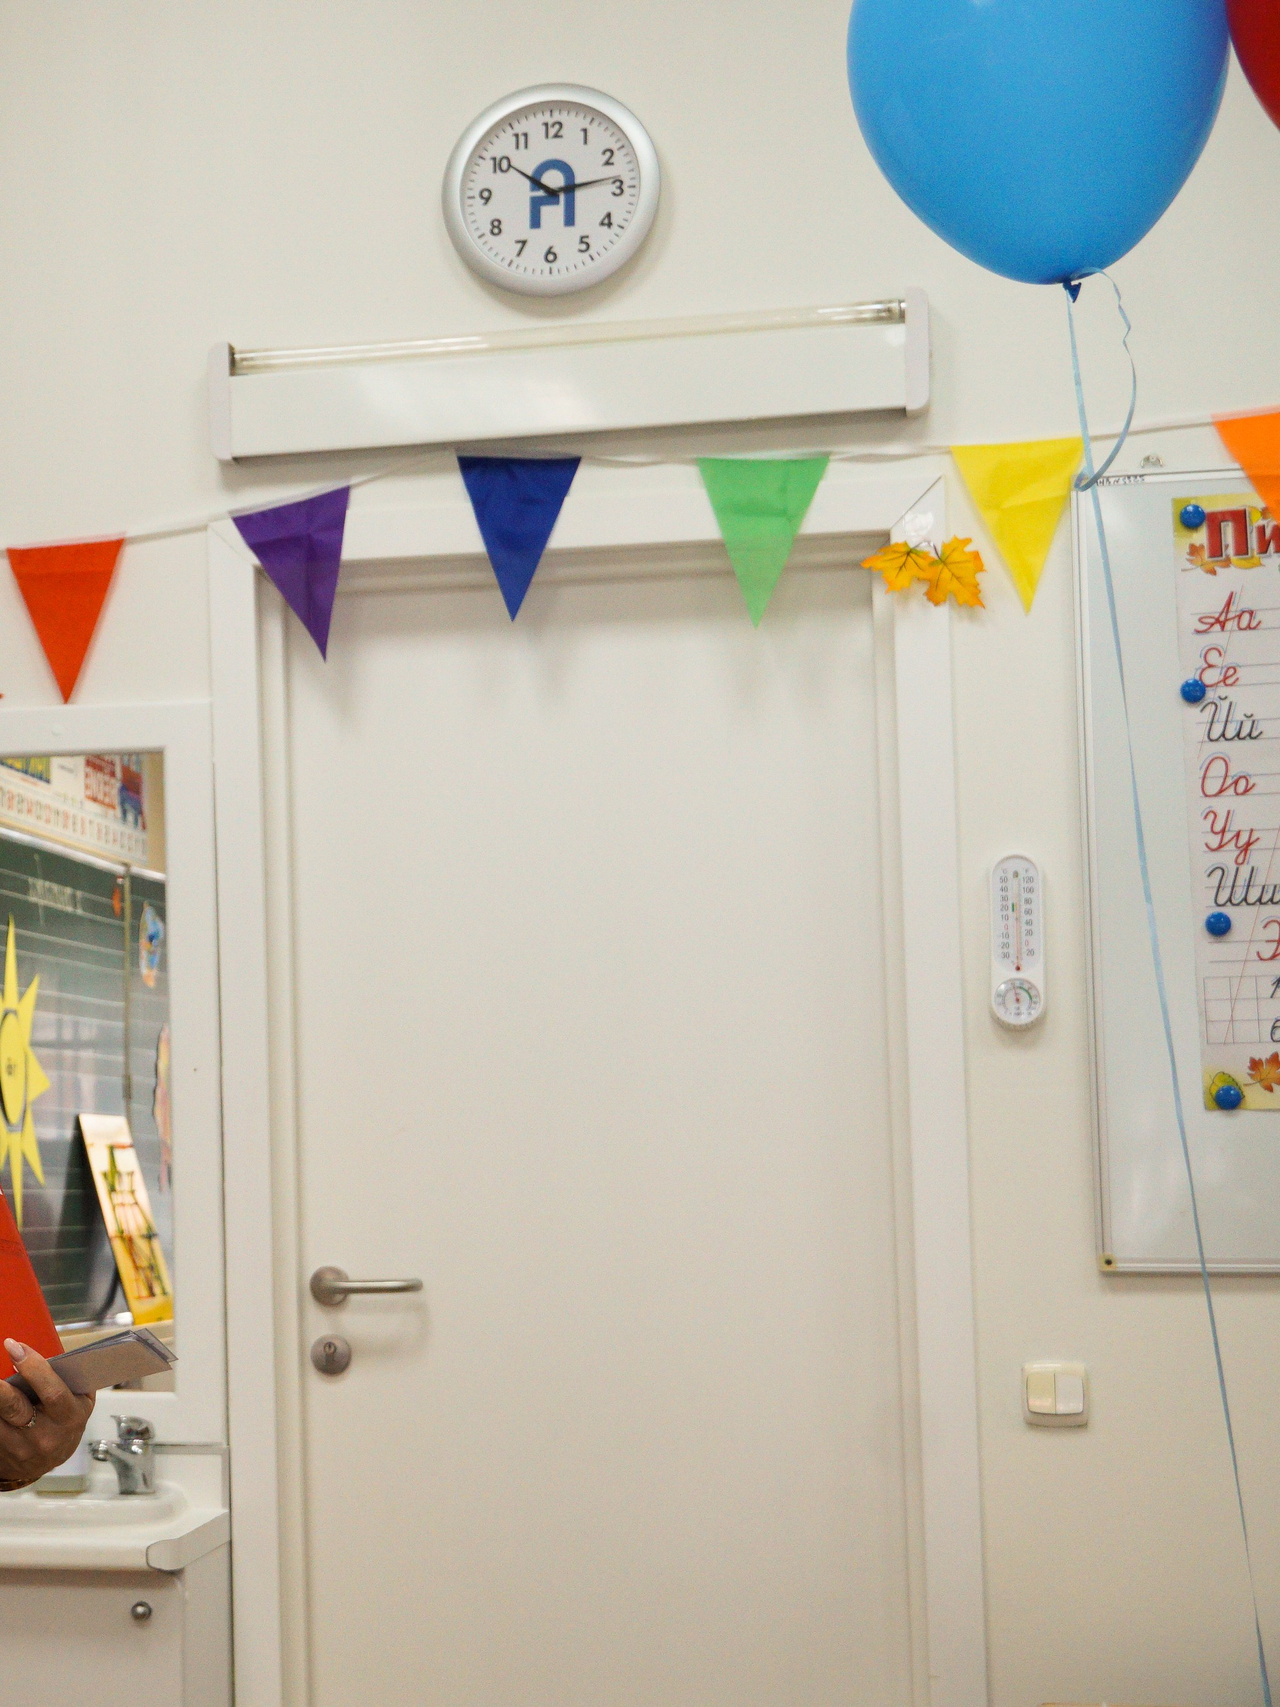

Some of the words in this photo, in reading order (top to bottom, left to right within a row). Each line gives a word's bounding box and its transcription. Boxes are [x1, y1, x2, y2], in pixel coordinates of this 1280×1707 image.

[542, 121, 563, 139] 12
[580, 128, 588, 145] 1
[512, 132, 528, 150] 11
[490, 156, 511, 173] 10
[601, 148, 615, 166] 2
[479, 188, 492, 206] 9
[611, 179, 624, 197] 3
[490, 219, 502, 236] 8
[599, 212, 613, 229] 4
[515, 240, 527, 257] 7
[578, 235, 590, 253] 5
[544, 246, 557, 263] 6
[1194, 591, 1261, 634] Аа
